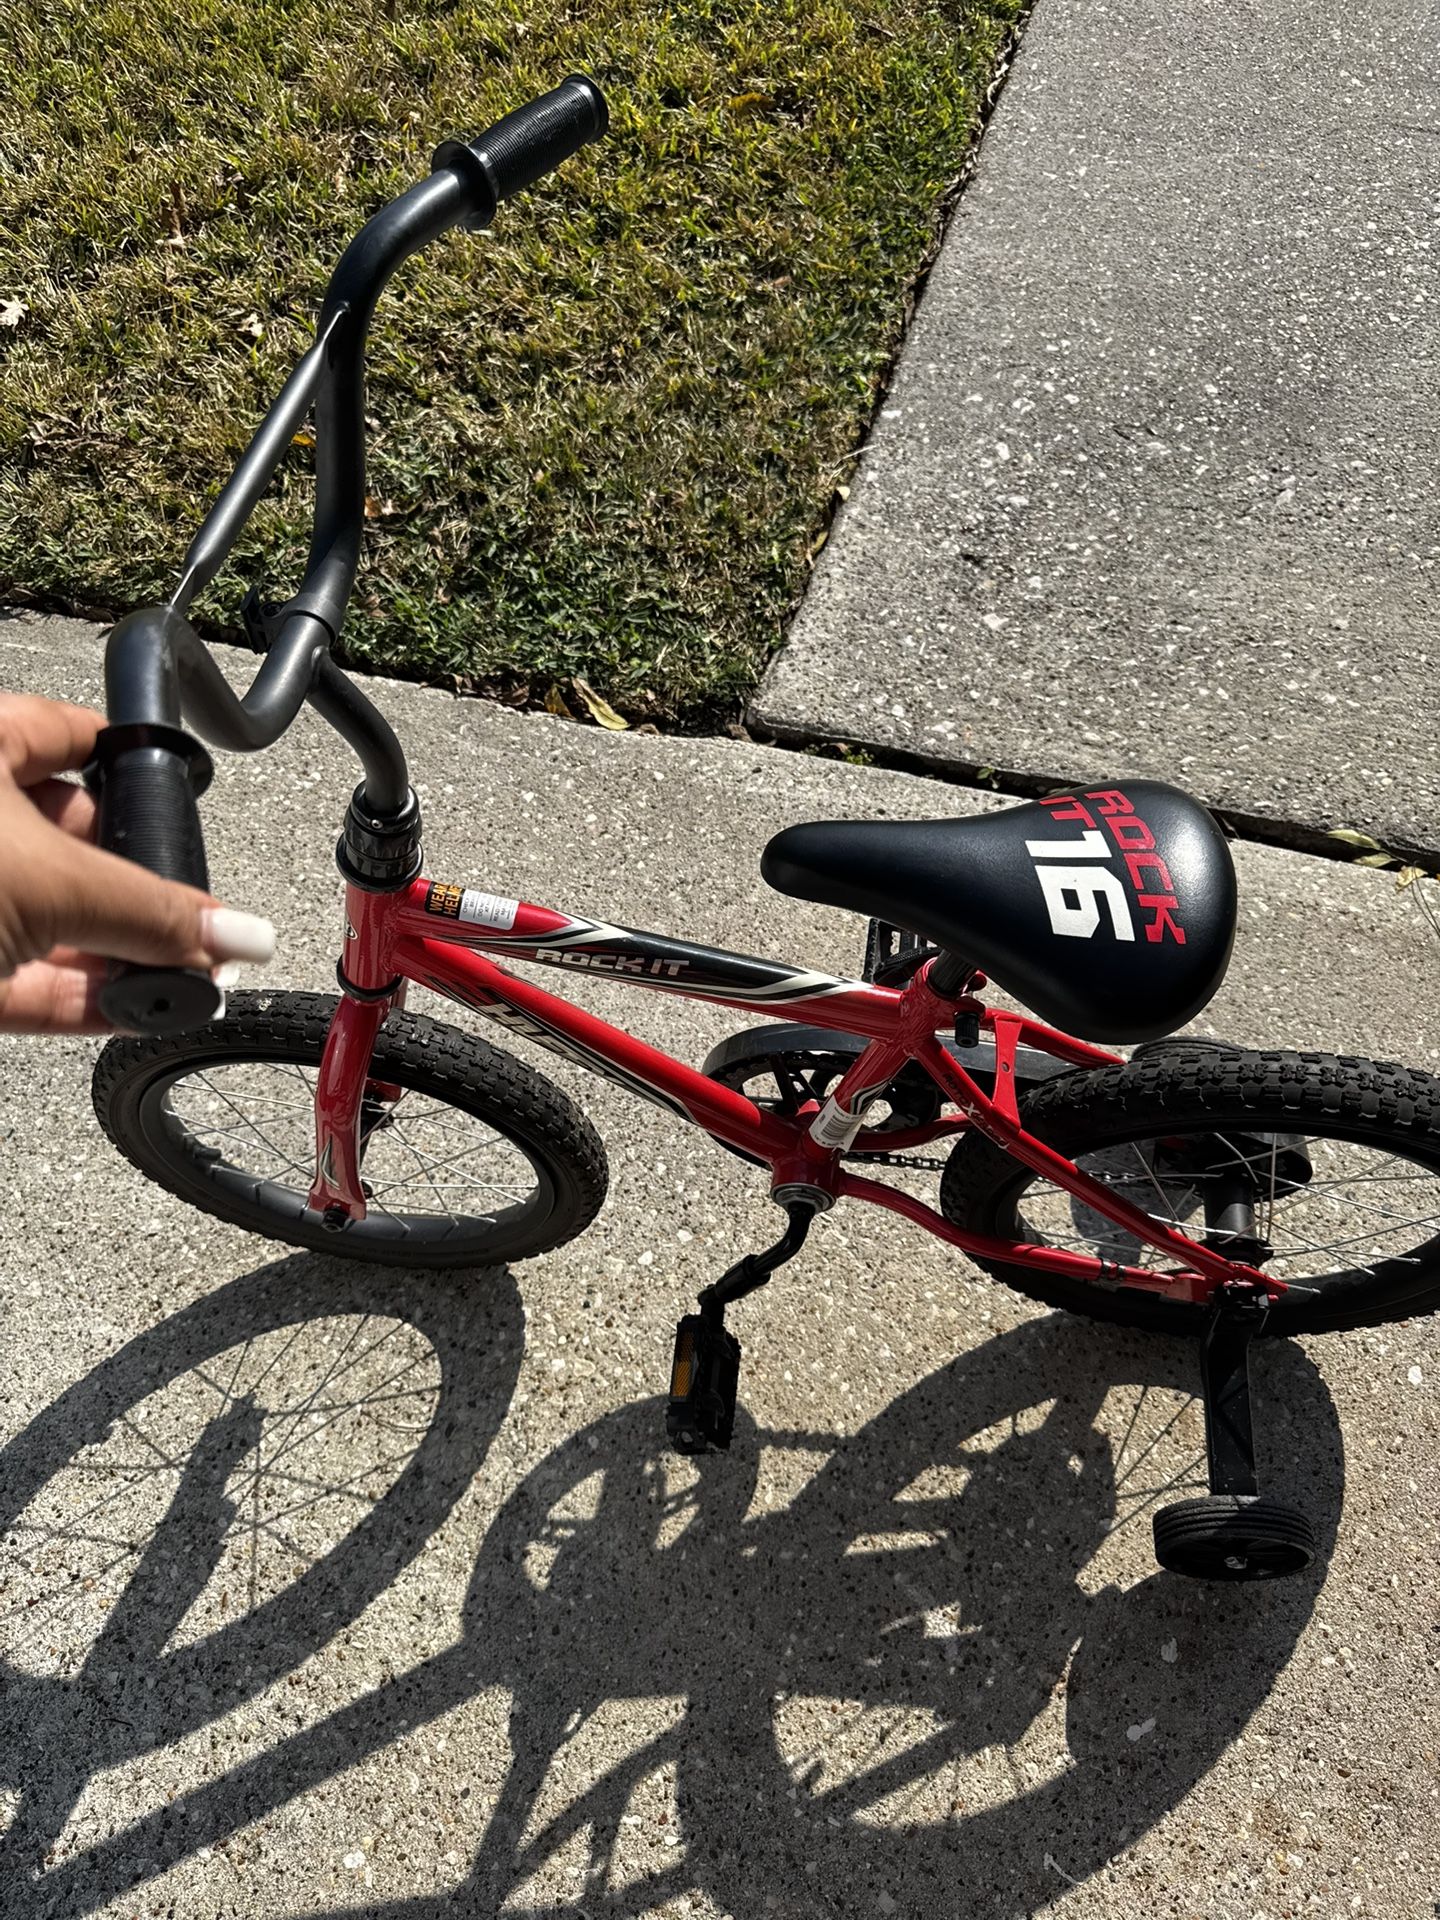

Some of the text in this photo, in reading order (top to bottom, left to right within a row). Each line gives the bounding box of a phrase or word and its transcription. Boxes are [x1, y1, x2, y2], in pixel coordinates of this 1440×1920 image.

[1039, 796, 1097, 829] IT
[1085, 790, 1187, 945] ROCK
[443, 885, 463, 916] HELME
[1025, 830, 1136, 942] 16
[535, 948, 690, 977] ROCK IT
